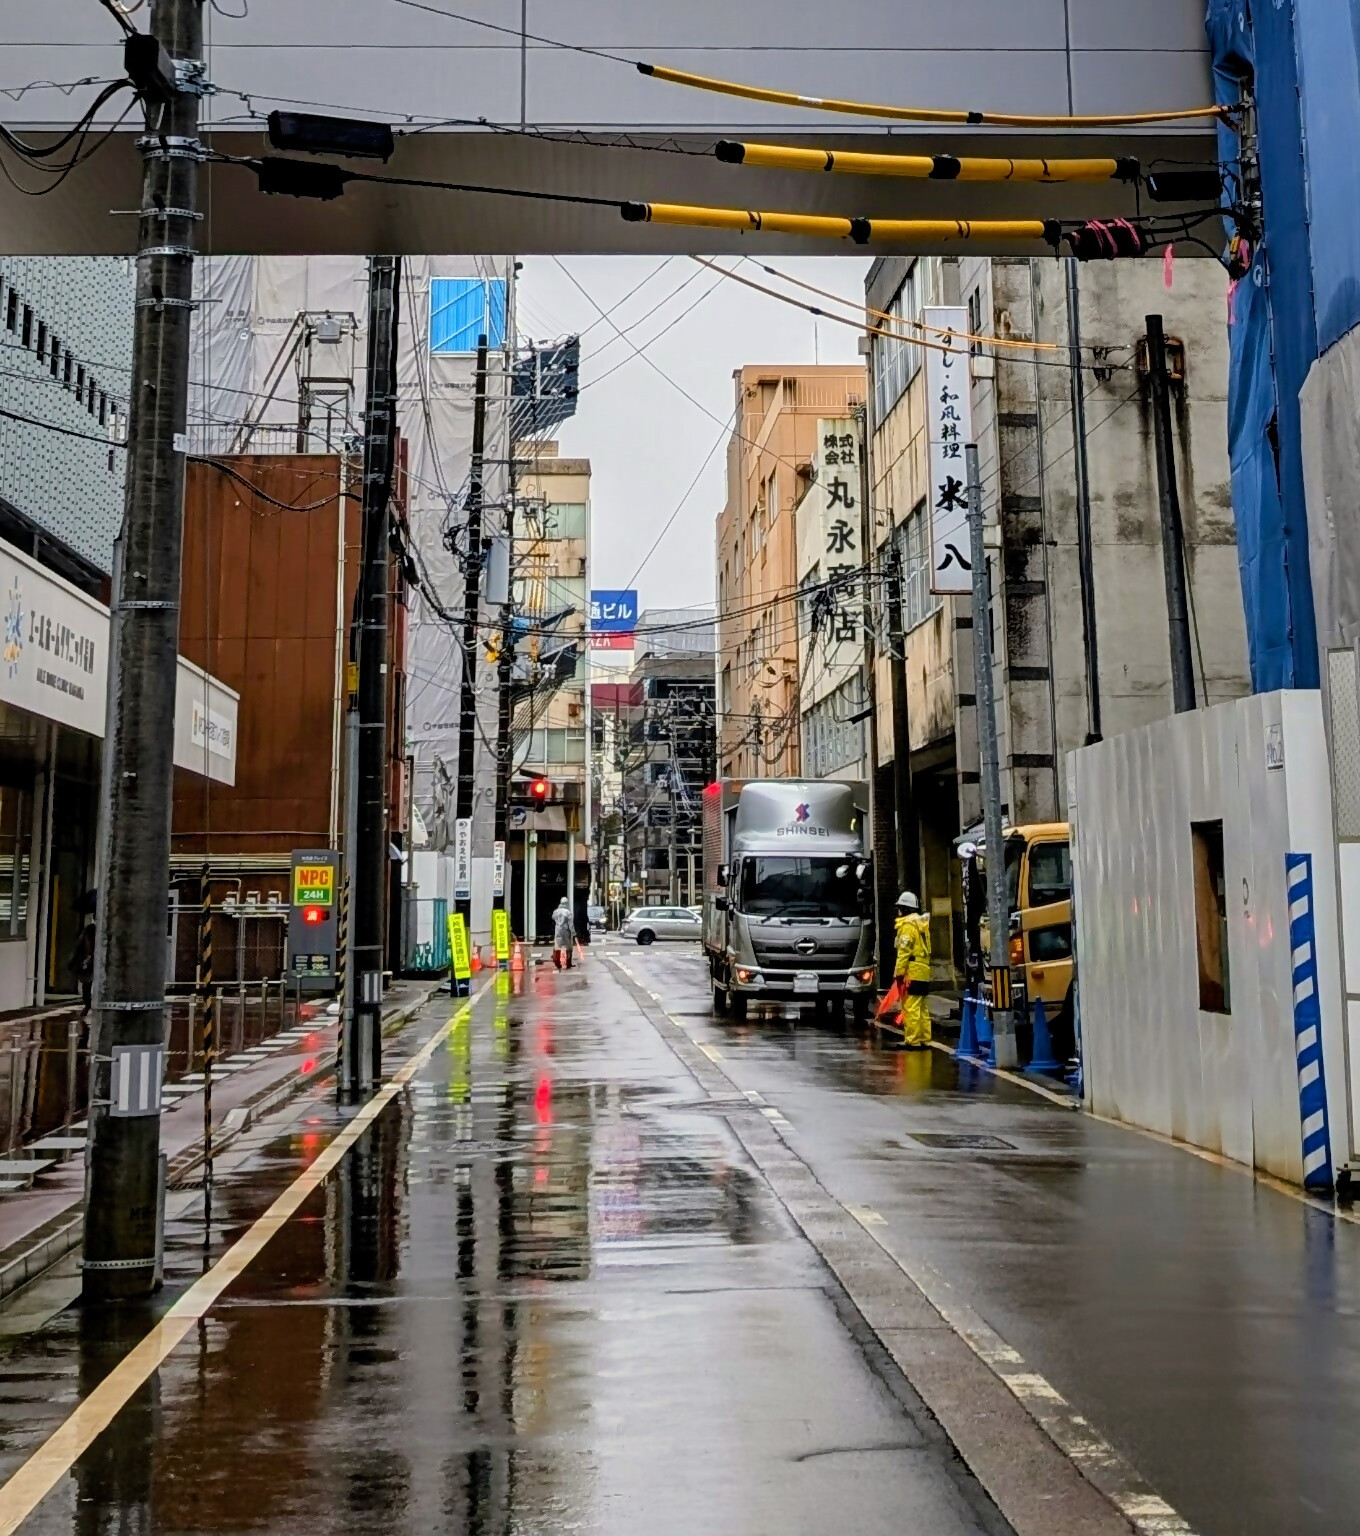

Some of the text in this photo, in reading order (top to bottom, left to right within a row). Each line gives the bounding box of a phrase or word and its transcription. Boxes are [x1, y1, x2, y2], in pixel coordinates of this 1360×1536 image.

[935, 475, 972, 571] 米八
[776, 826, 830, 837] SHINSEI
[300, 869, 329, 886] NPC
[303, 890, 324, 899] 24H
